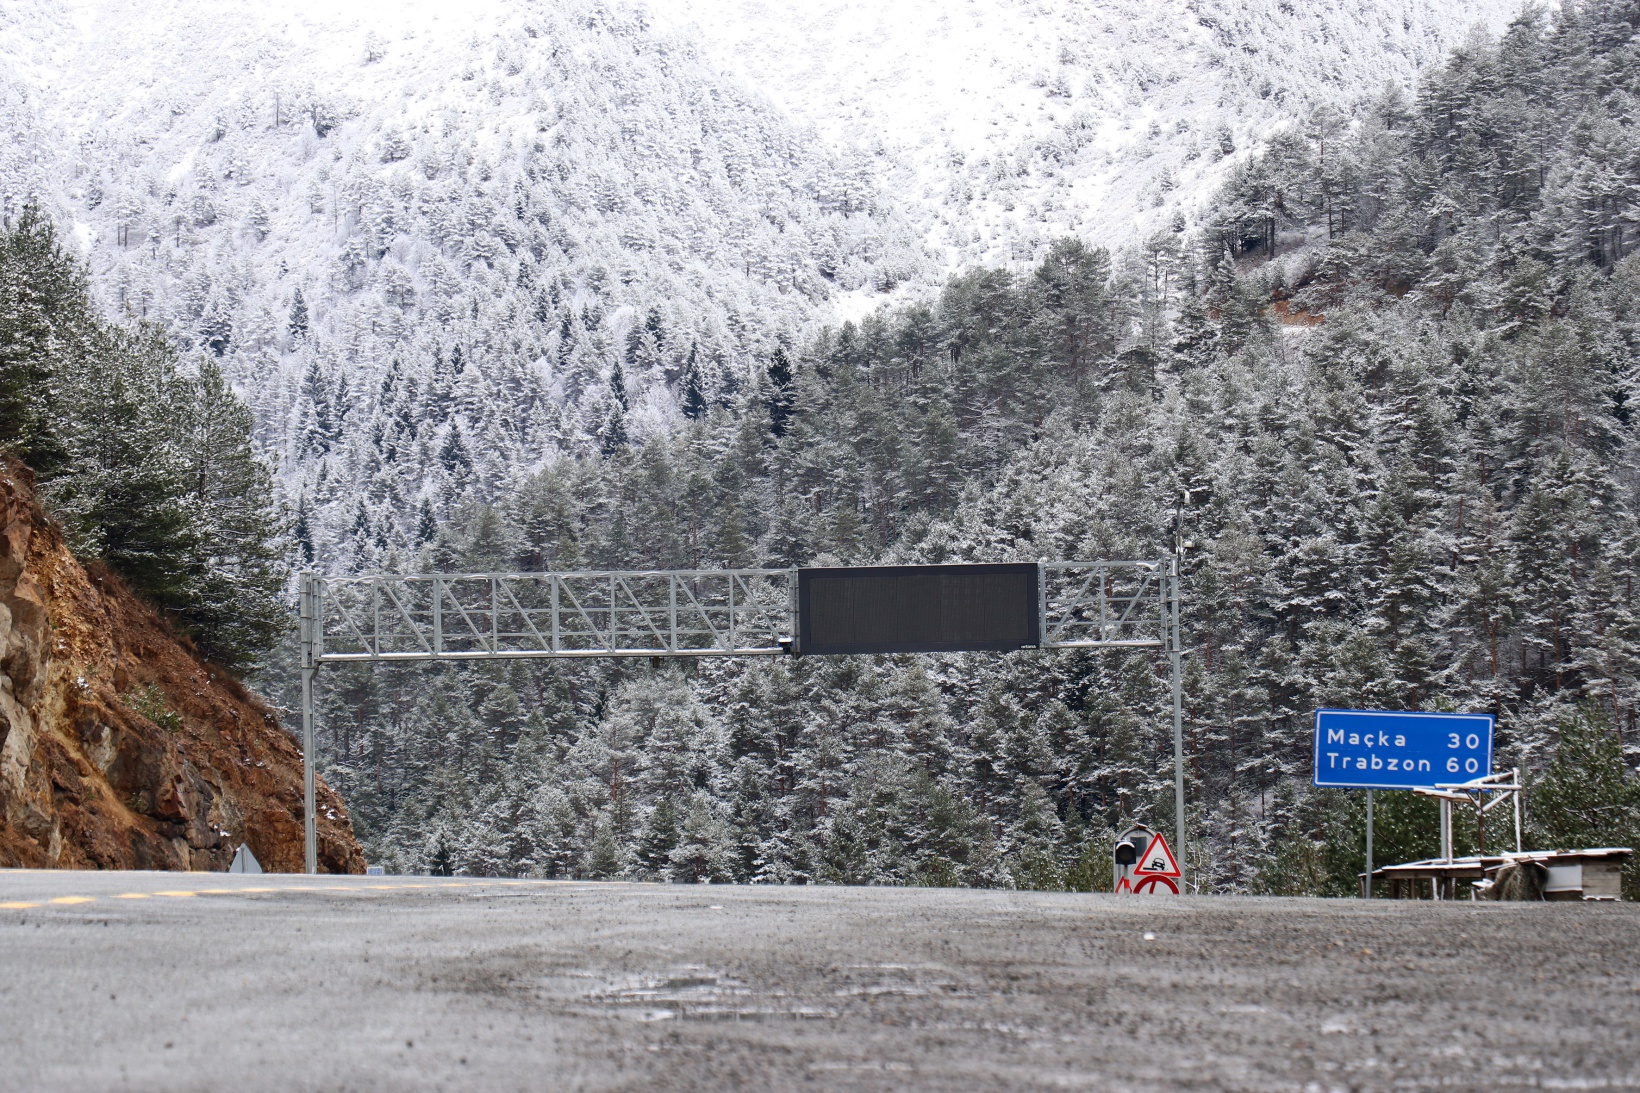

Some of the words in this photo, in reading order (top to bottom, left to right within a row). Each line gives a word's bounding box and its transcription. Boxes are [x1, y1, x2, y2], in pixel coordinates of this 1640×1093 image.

[1327, 729, 1406, 748] Maçka
[1447, 733, 1479, 749] 30
[1327, 752, 1431, 772] Trabzon
[1446, 757, 1479, 773] 60
